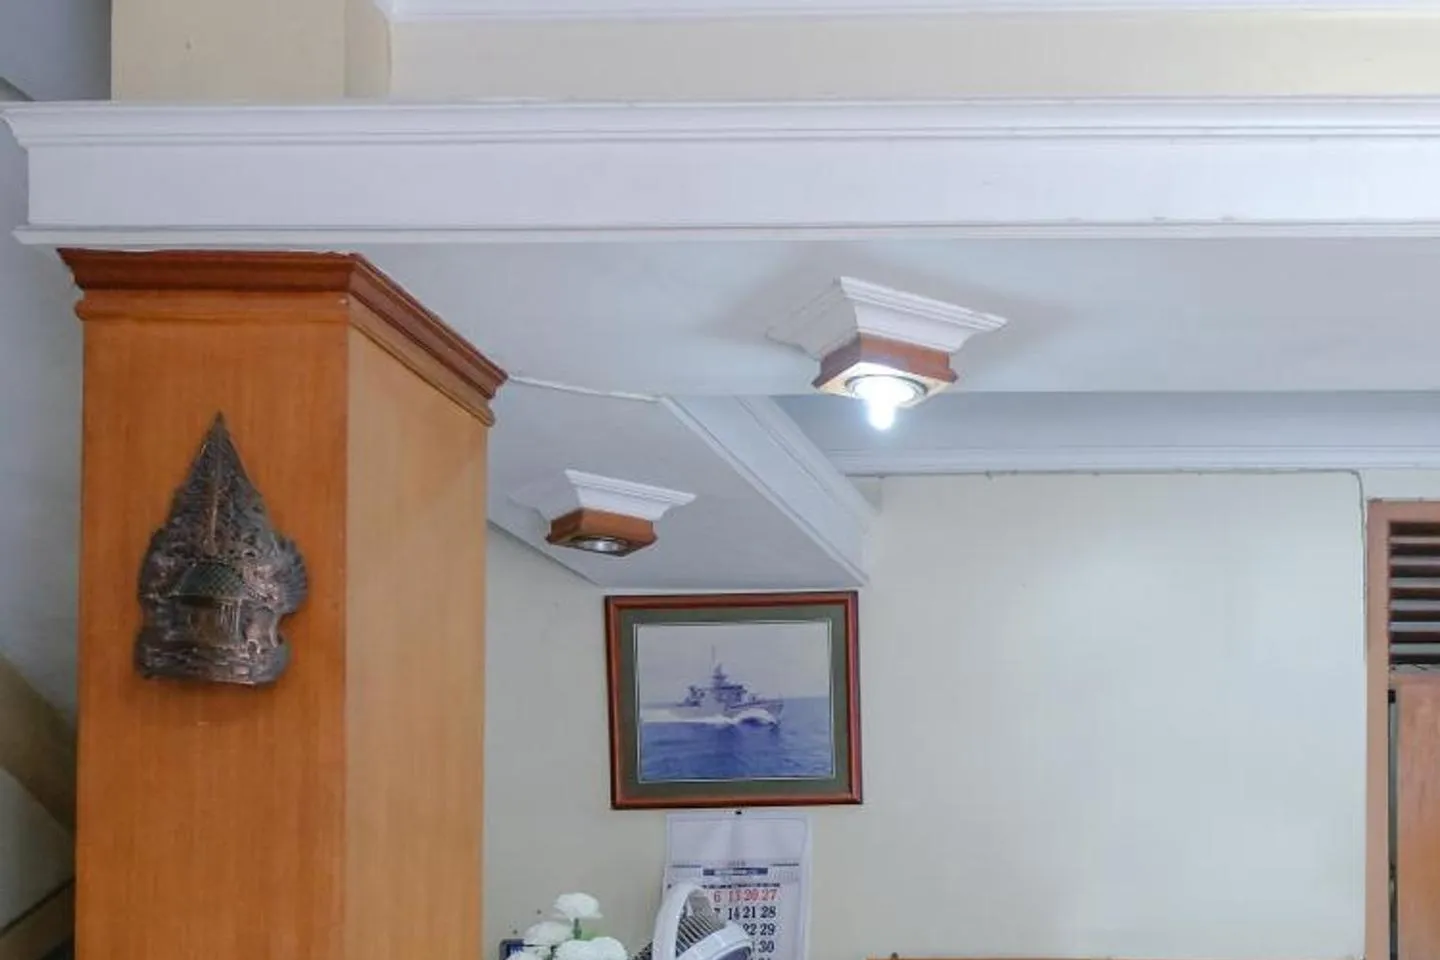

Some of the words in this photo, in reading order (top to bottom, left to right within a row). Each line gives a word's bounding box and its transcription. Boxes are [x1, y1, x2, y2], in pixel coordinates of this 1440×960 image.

[713, 891, 721, 903] 6
[761, 889, 777, 901] 27
[743, 906, 756, 919] 21
[760, 906, 776, 918] 28
[759, 923, 775, 936] 29
[758, 940, 774, 953] 30
